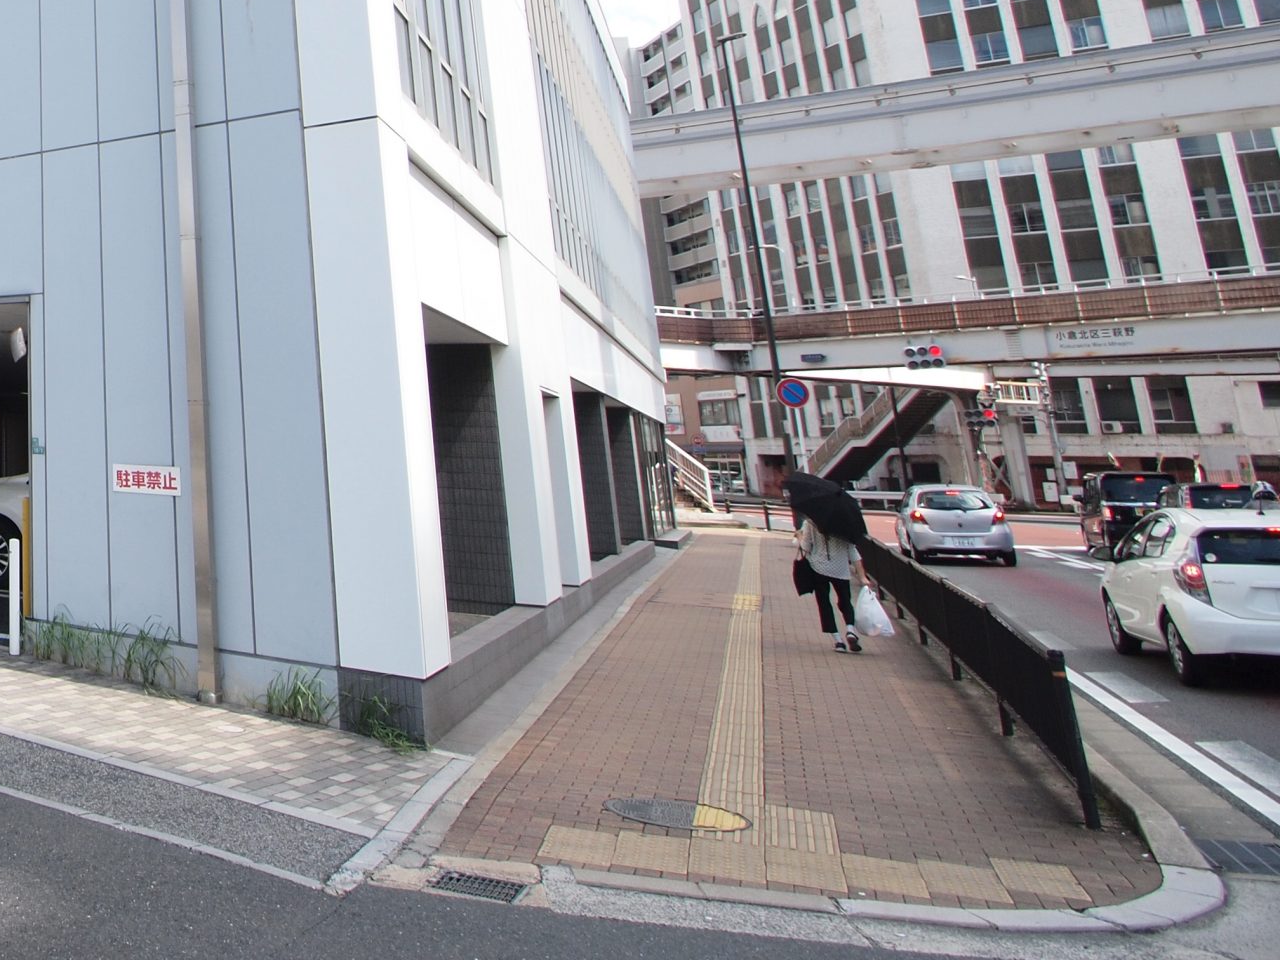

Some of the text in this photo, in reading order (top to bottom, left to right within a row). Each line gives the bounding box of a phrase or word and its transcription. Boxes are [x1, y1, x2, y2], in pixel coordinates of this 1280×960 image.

[1055, 326, 1136, 342] 小倉北区三萩野
[115, 469, 178, 491] 駐車禁止
